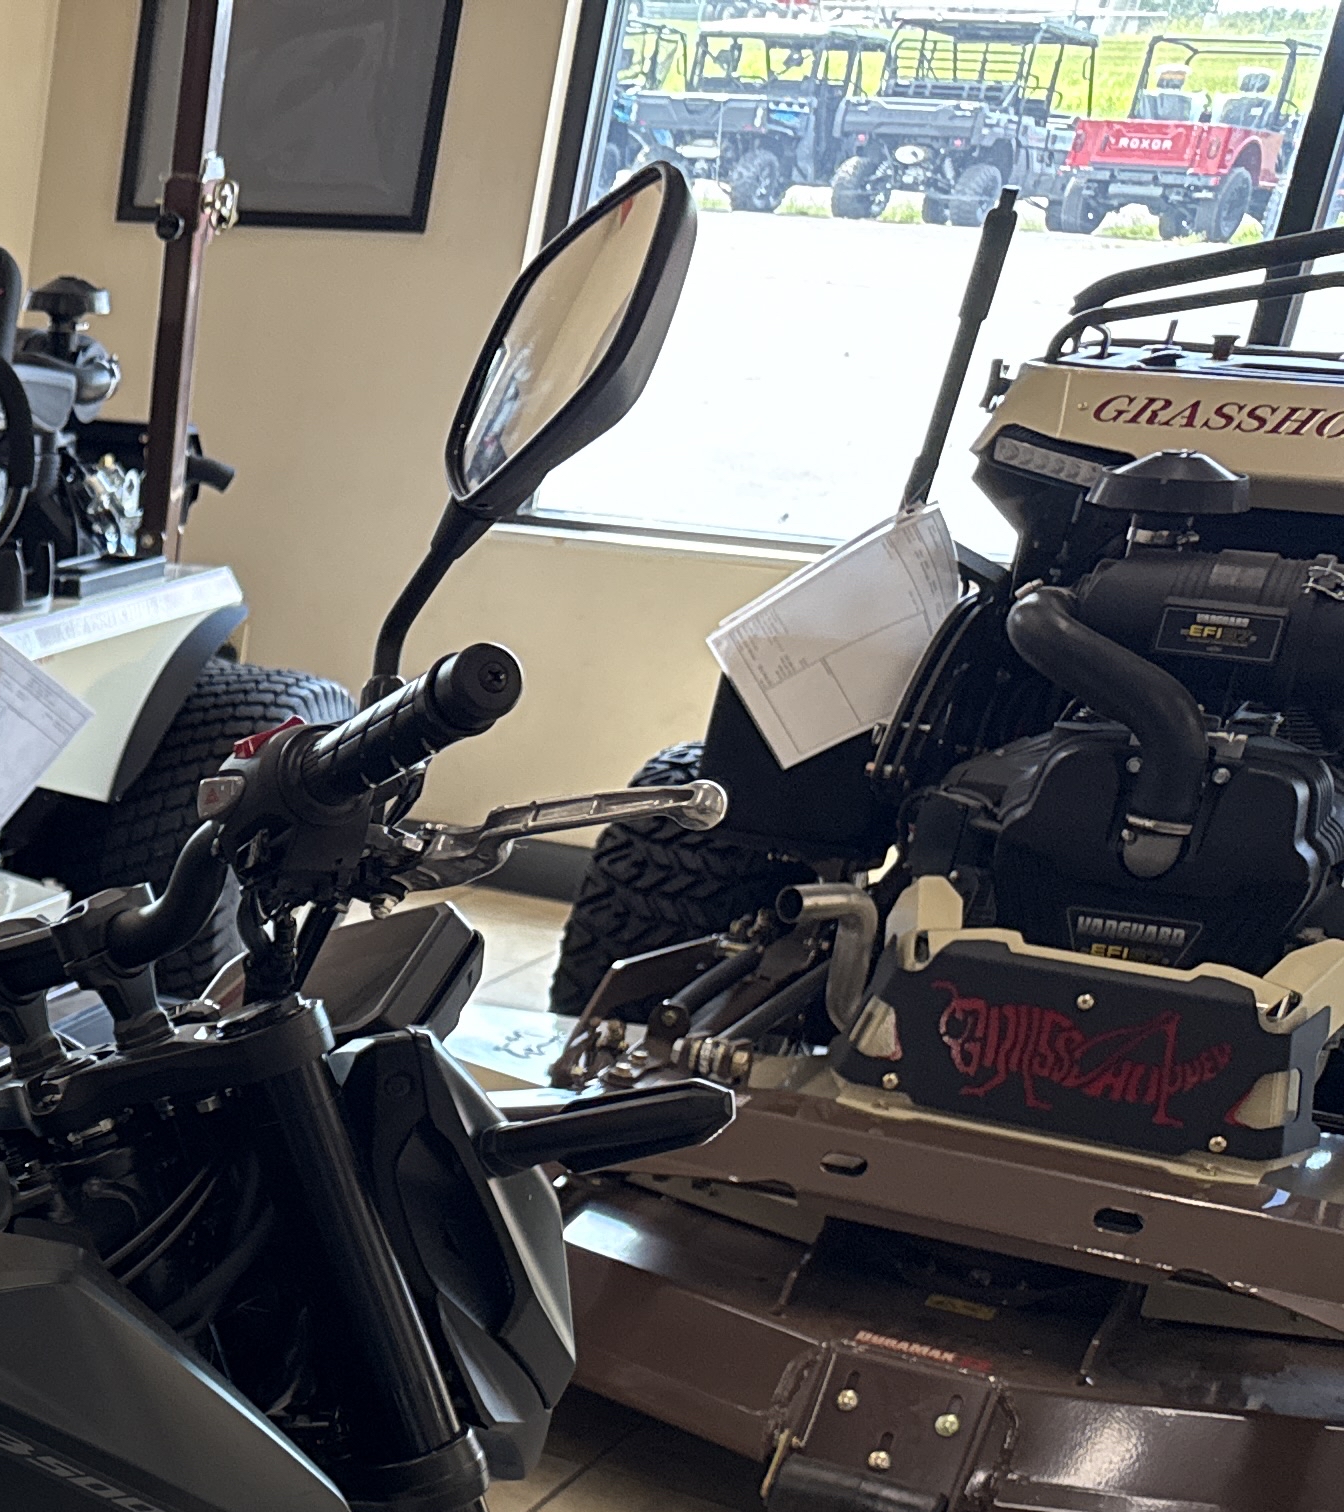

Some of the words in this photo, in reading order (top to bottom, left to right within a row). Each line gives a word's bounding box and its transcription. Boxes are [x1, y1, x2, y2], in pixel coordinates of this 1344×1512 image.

[1118, 137, 1172, 150] ROXOR
[1189, 624, 1223, 639] EFI
[1076, 915, 1185, 947] VANGUARD
[1090, 943, 1129, 960] EFI
